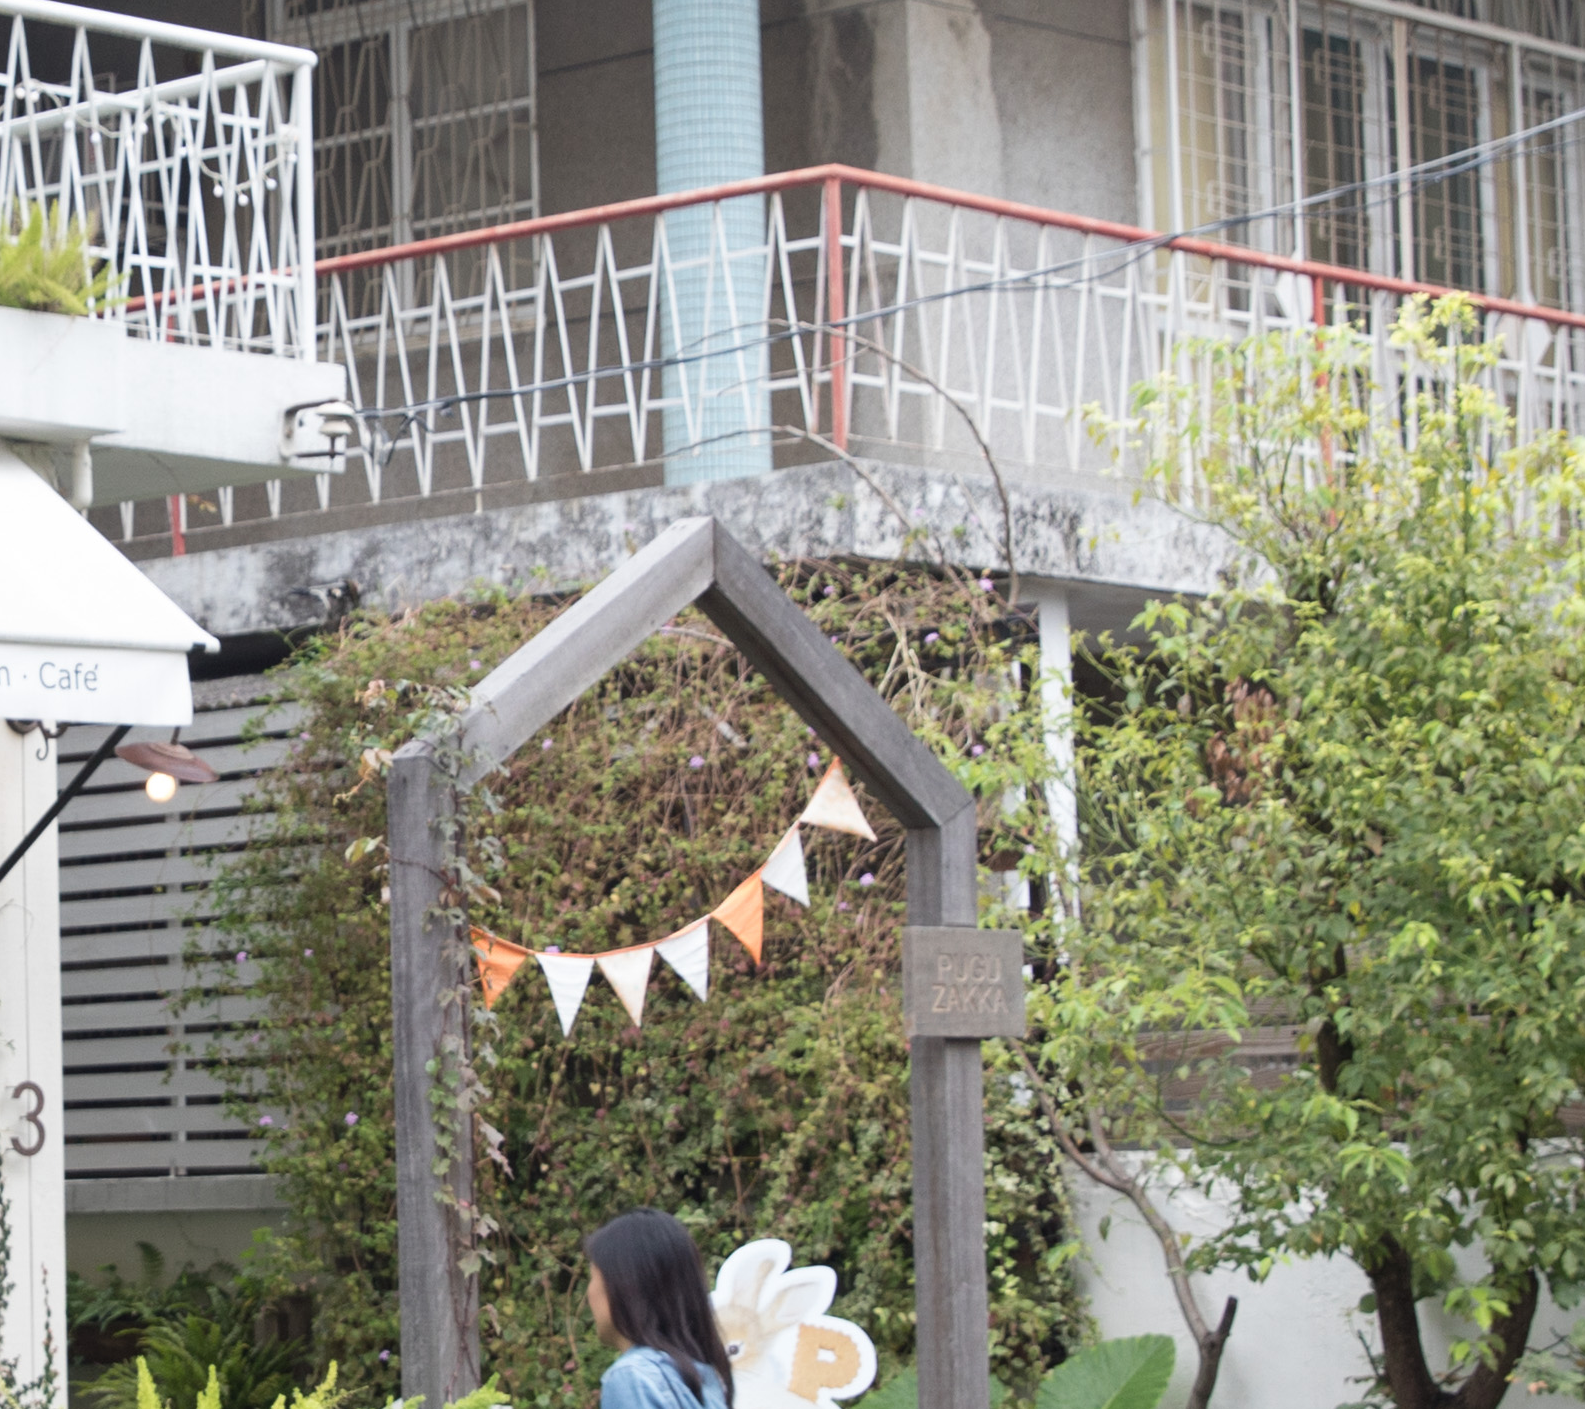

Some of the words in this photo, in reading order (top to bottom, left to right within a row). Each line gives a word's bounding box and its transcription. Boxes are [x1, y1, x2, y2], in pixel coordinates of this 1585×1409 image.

[38, 661, 100, 692] Café
[937, 953, 1002, 983] PUGU
[931, 984, 1009, 1014] ZAKKA
[11, 1081, 45, 1156] 3
